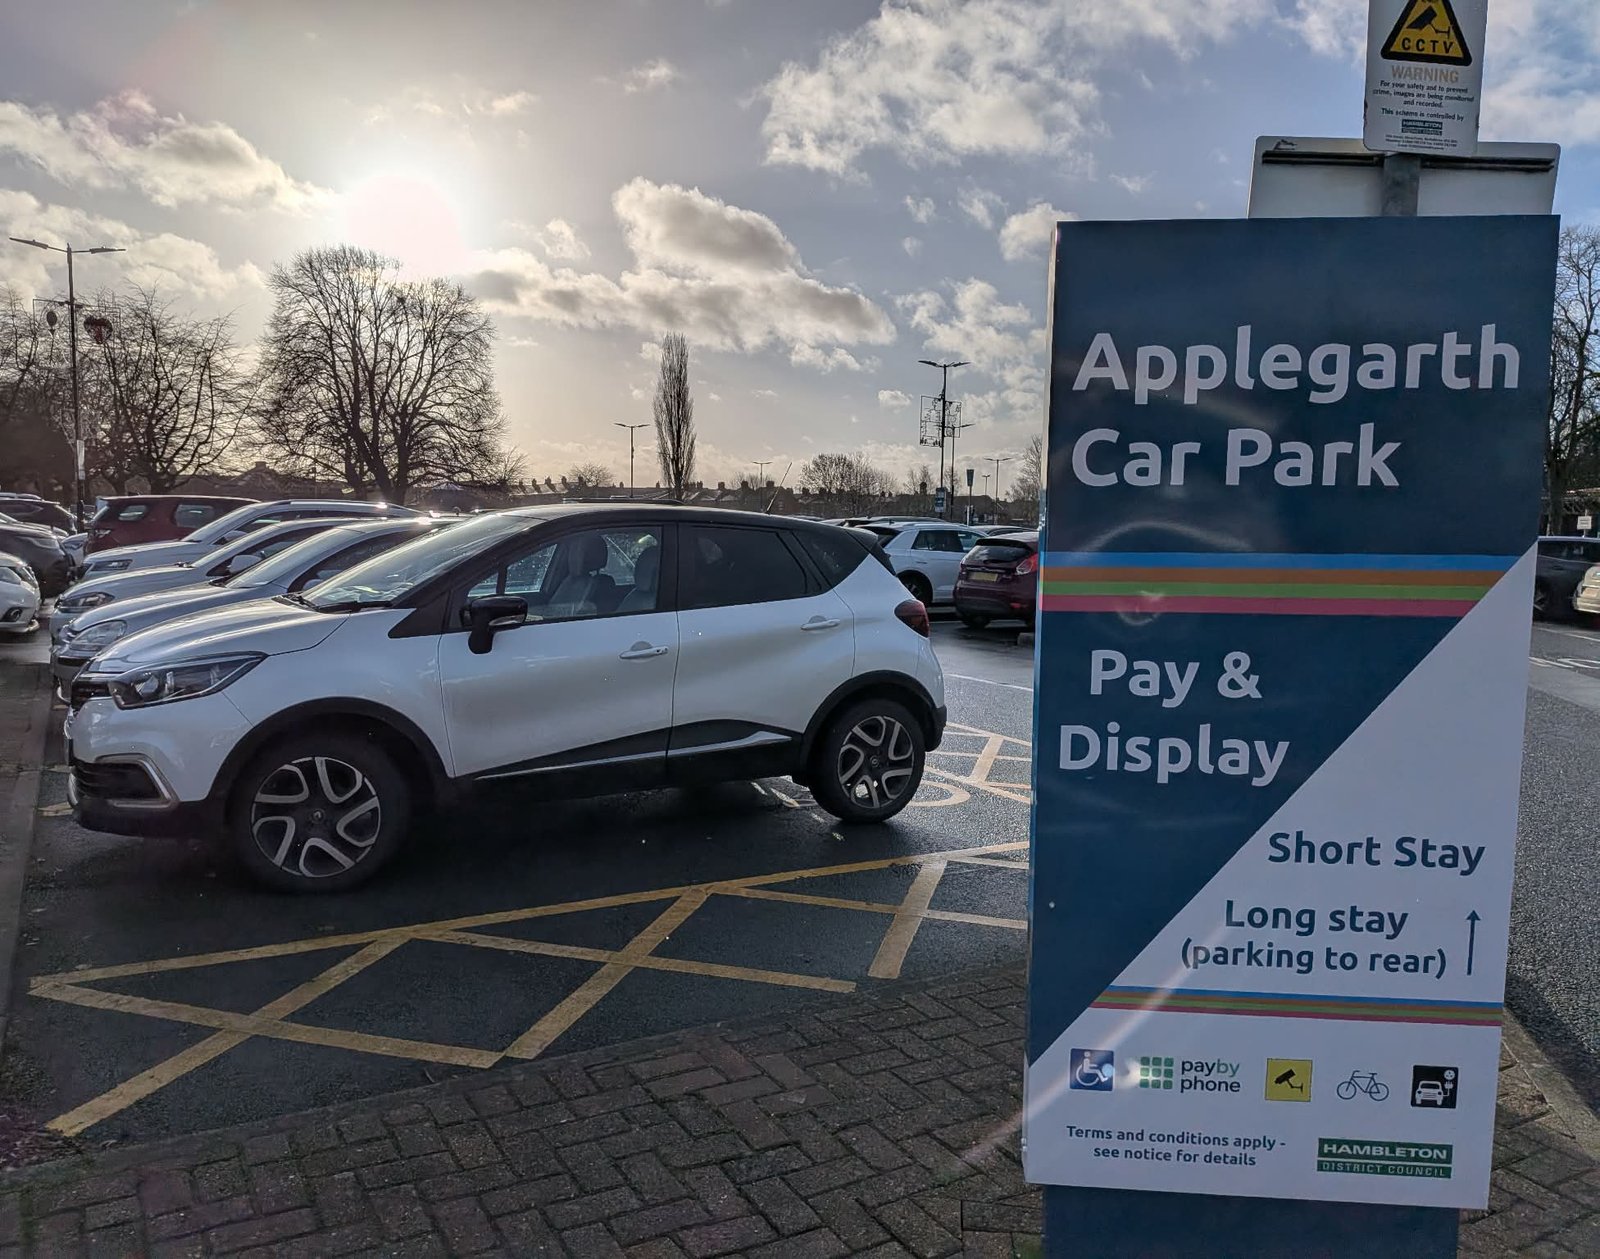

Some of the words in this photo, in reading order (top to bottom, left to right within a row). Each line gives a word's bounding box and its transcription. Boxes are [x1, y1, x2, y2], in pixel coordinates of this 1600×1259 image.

[1401, 37, 1454, 54] CCTV
[1391, 65, 1460, 83] WARNING
[1407, 83, 1424, 91] safety
[1446, 86, 1468, 94] prevent
[1427, 92, 1443, 100] being
[1416, 100, 1443, 108] recorded.
[1426, 111, 1456, 120] controlled
[1457, 113, 1464, 122] by
[1072, 324, 1520, 405] Applegarth
[1071, 428, 1201, 487] Car
[1225, 422, 1402, 487] Park
[1090, 649, 1200, 708] Pay
[1217, 651, 1263, 699] &
[1059, 721, 1290, 787] Display
[1268, 830, 1381, 866] Short
[1393, 836, 1486, 876] Stay
[1225, 899, 1316, 937] Long
[1328, 905, 1409, 940] stay
[1181, 937, 1314, 974] (parking
[1325, 947, 1358, 971] to
[1369, 948, 1447, 980] rear)
[1181, 1058, 1240, 1078] payby
[1180, 1076, 1241, 1094] phone
[1066, 1125, 1113, 1140] Terms
[1116, 1129, 1145, 1142] and
[1149, 1131, 1229, 1147] conditions
[1233, 1135, 1277, 1151] apply
[1093, 1147, 1120, 1158] see
[1124, 1148, 1172, 1162] notice
[1176, 1150, 1200, 1164] for
[1203, 1151, 1257, 1166] details
[1323, 1143, 1447, 1160] HAMBLETON
[1322, 1162, 1382, 1174] DISTRICT
[1388, 1165, 1446, 1177] COUNCIL
